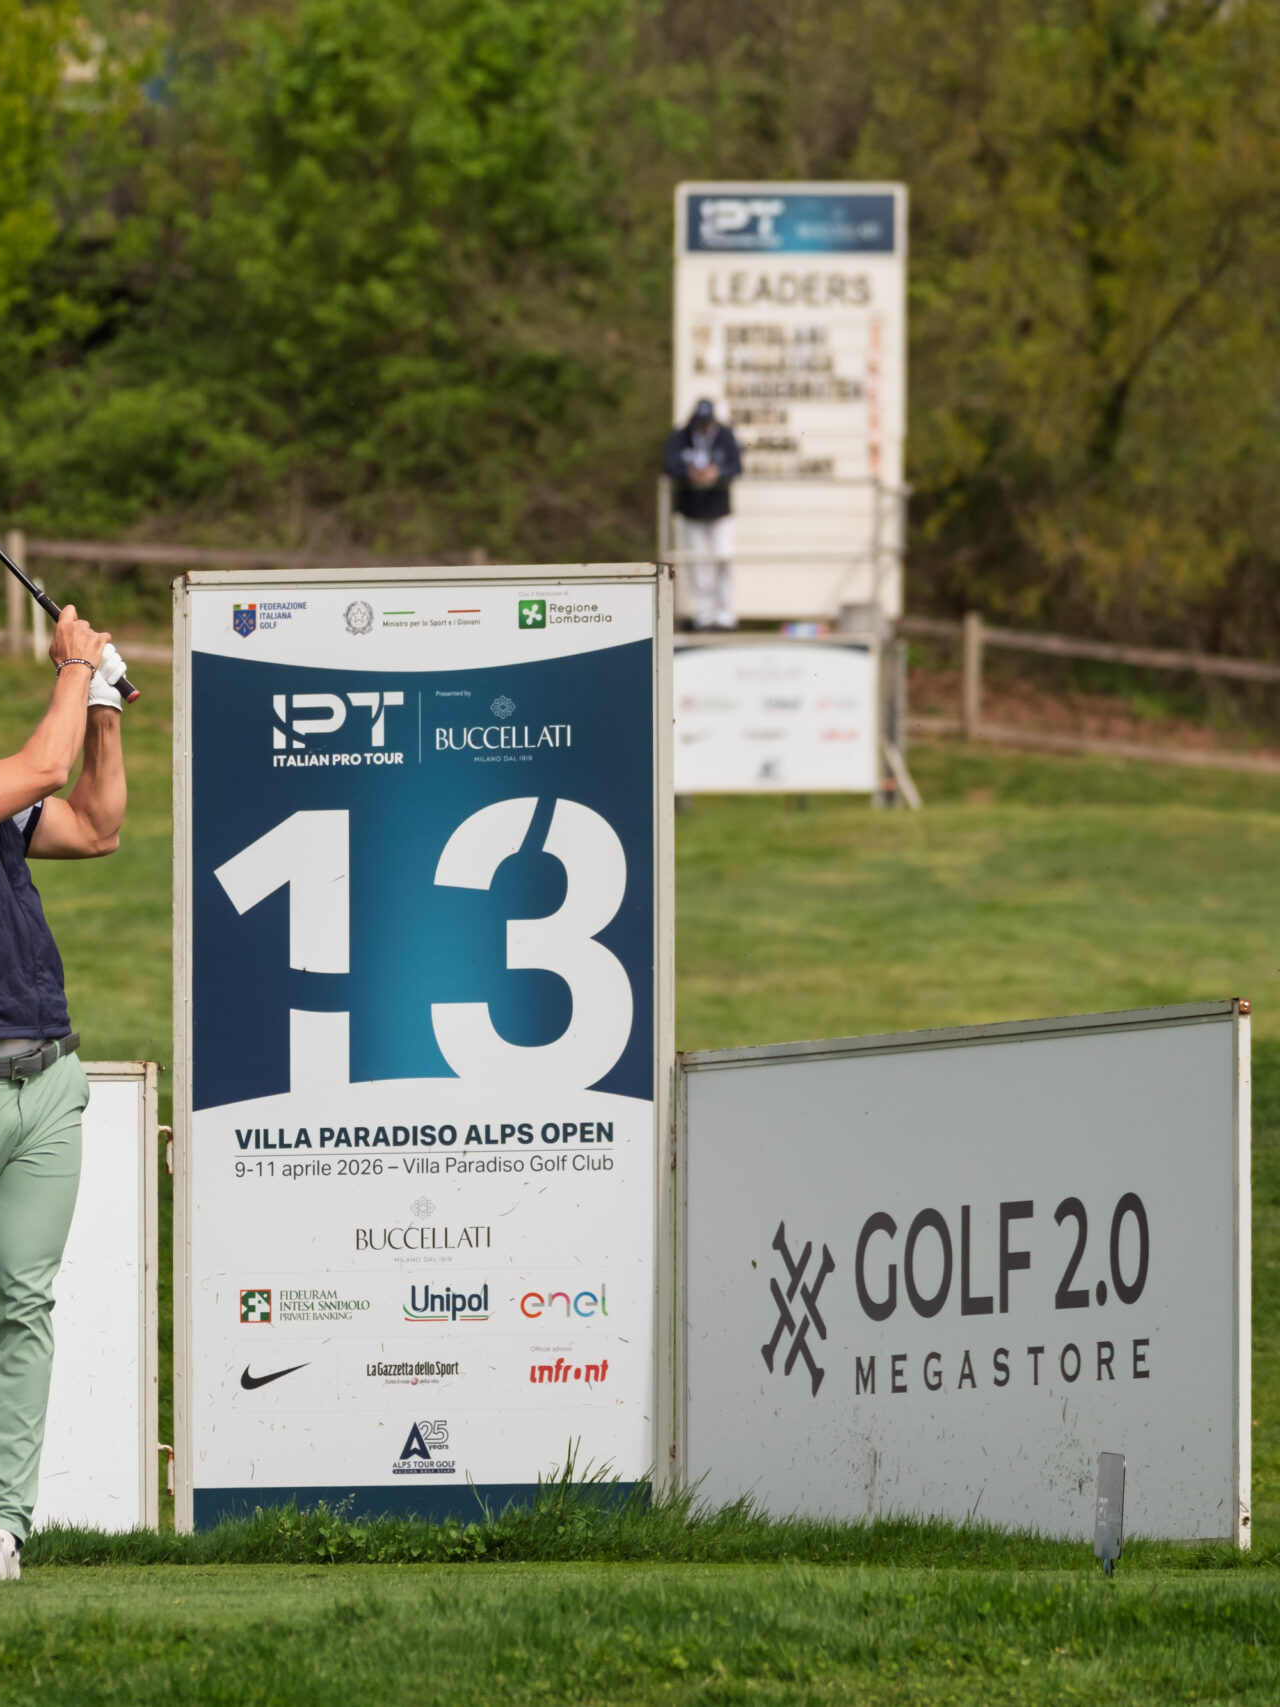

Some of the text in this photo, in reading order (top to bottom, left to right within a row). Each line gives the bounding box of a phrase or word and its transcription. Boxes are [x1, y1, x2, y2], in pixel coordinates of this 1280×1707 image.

[707, 272, 873, 306] LEADERS
[259, 602, 307, 610] FEDERAZIONE
[549, 603, 598, 615] Regione
[259, 612, 292, 620] ITALIANA
[429, 619, 447, 628] Sport
[549, 613, 613, 624] Lombardia
[259, 621, 278, 630] GOLF
[273, 691, 404, 749] IPT
[435, 724, 571, 751] BUCCELLATI
[273, 752, 404, 767] ITALIAN PRO TOUR
[474, 755, 502, 763] MILANO
[214, 797, 634, 1094] 13
[234, 1121, 614, 1150] VILLA PARADISO ALPS OPEN
[234, 1161, 275, 1178] 9-11
[282, 1159, 332, 1181] aprile
[337, 1158, 384, 1176] 2026
[403, 1156, 440, 1174] Villa
[446, 1155, 525, 1174] Paradiso
[530, 1154, 567, 1172] Golf
[572, 1153, 614, 1171] Club
[356, 1226, 491, 1251] BUCCELLATI
[854, 1191, 1150, 1322] GOLF 2.0
[280, 1289, 337, 1300] FIDEURAM
[411, 1283, 489, 1321] Unipol
[520, 1283, 609, 1319] enel
[280, 1299, 370, 1312] INTESA SANPAOLO
[280, 1311, 353, 1321] PRIVATE BANKING
[366, 1361, 459, 1378] La Gazzetta dello Sport
[529, 1357, 609, 1383] infront
[854, 1338, 1151, 1396] MEGASTORE
[392, 1460, 456, 1469] ALPS TOUR GOLF
